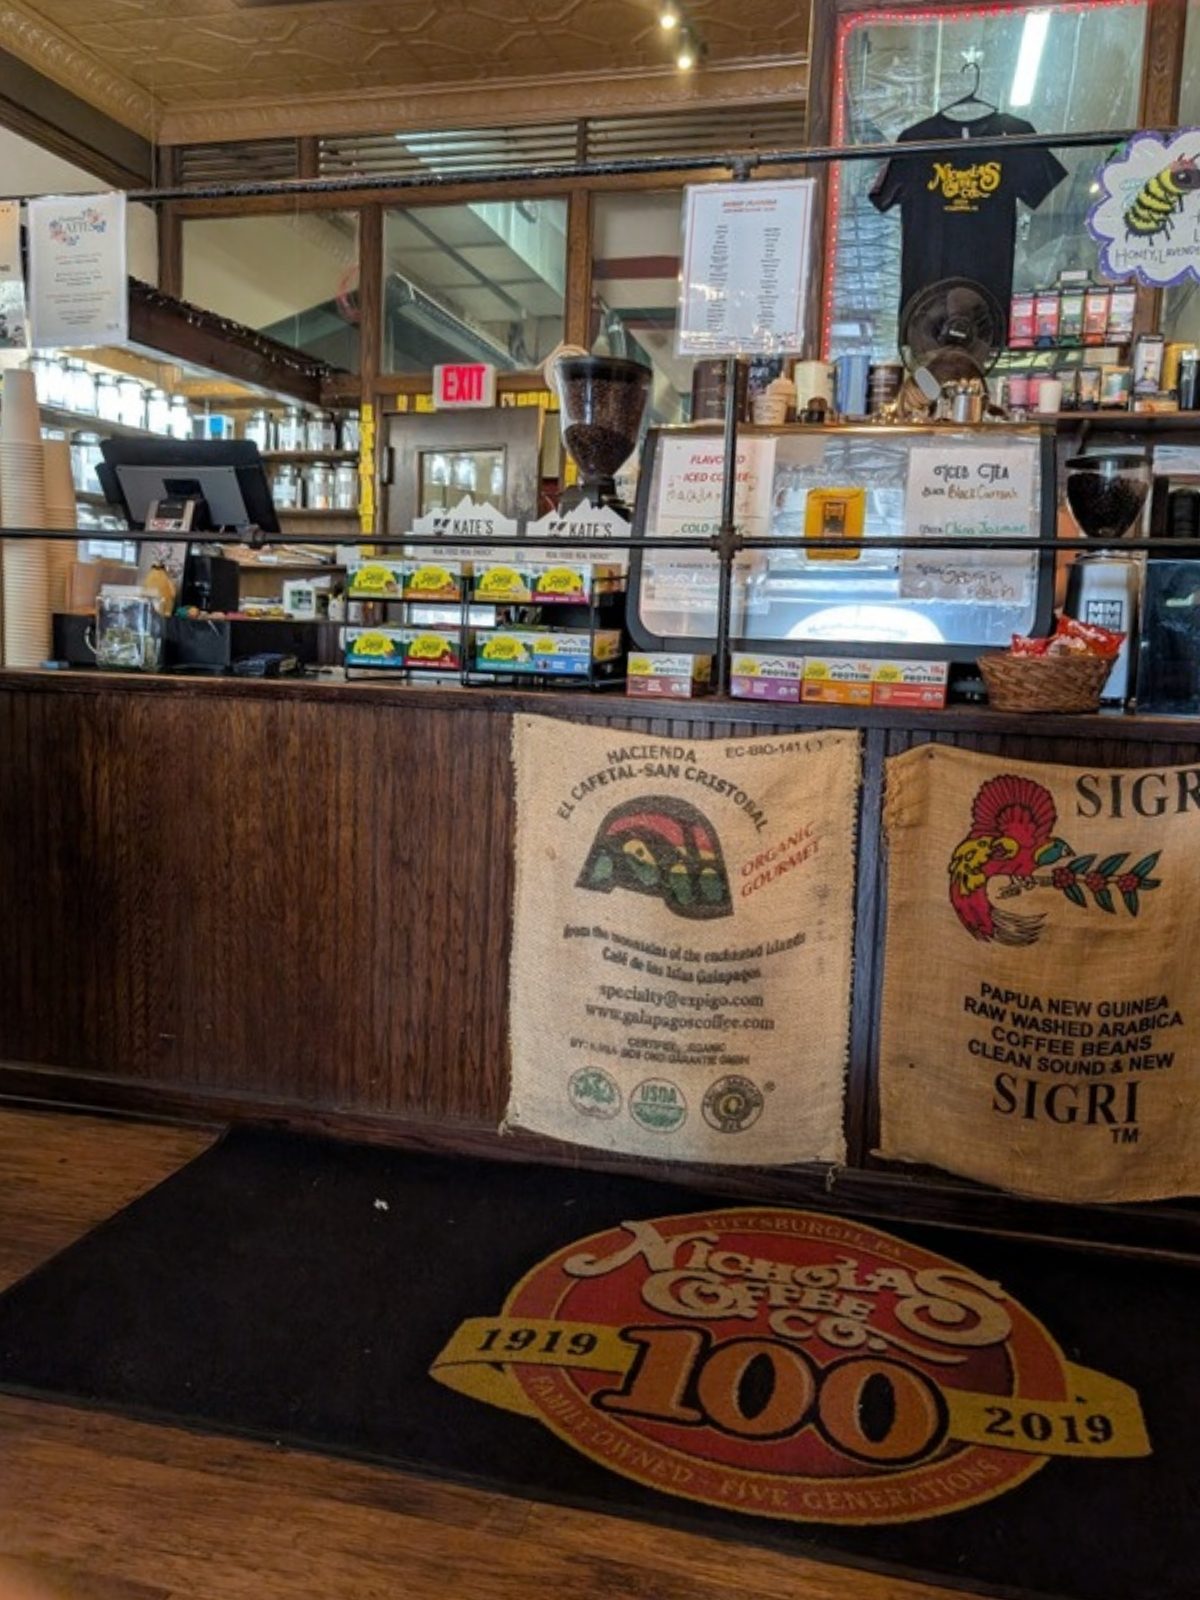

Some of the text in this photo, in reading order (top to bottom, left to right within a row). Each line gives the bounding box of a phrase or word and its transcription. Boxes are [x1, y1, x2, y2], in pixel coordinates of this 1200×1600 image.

[442, 366, 486, 402] EXIT
[683, 472, 750, 483] ICED COEE
[690, 454, 746, 465] FLAVOD
[453, 519, 494, 535] KATE'S
[569, 522, 613, 537] KATE'S
[681, 522, 709, 534] COLD
[606, 745, 697, 765] HACIENDA
[557, 762, 769, 834] EL CAFETAL-SAN CRISTOBAL
[741, 820, 815, 878] ORGANIC
[740, 840, 821, 898] GOURMET
[600, 983, 764, 1011] specialty@expigo.com
[980, 982, 1169, 1018] PAPUA NEW GUINEA
[585, 1003, 775, 1032] www.galapagoscoffee.com
[963, 995, 1183, 1039] RAW WASHED ARABICA
[967, 1039, 1175, 1077] CLEAN SOUND & NEW
[991, 1026, 1153, 1058] COFFEE BEANS
[641, 1084, 678, 1104] USDA
[992, 1071, 1141, 1126] SIGRI
[1109, 1127, 1139, 1145] TM
[563, 1220, 1012, 1362] NICHOLAS
[641, 1269, 878, 1322] COFFEE
[475, 1326, 599, 1356] 1919
[768, 1311, 889, 1352] CO.
[591, 1325, 950, 1468] 100
[985, 1406, 1114, 1445] 2019
[719, 1478, 790, 1508] FIVE
[803, 1458, 1001, 1511] GENERATIONS
